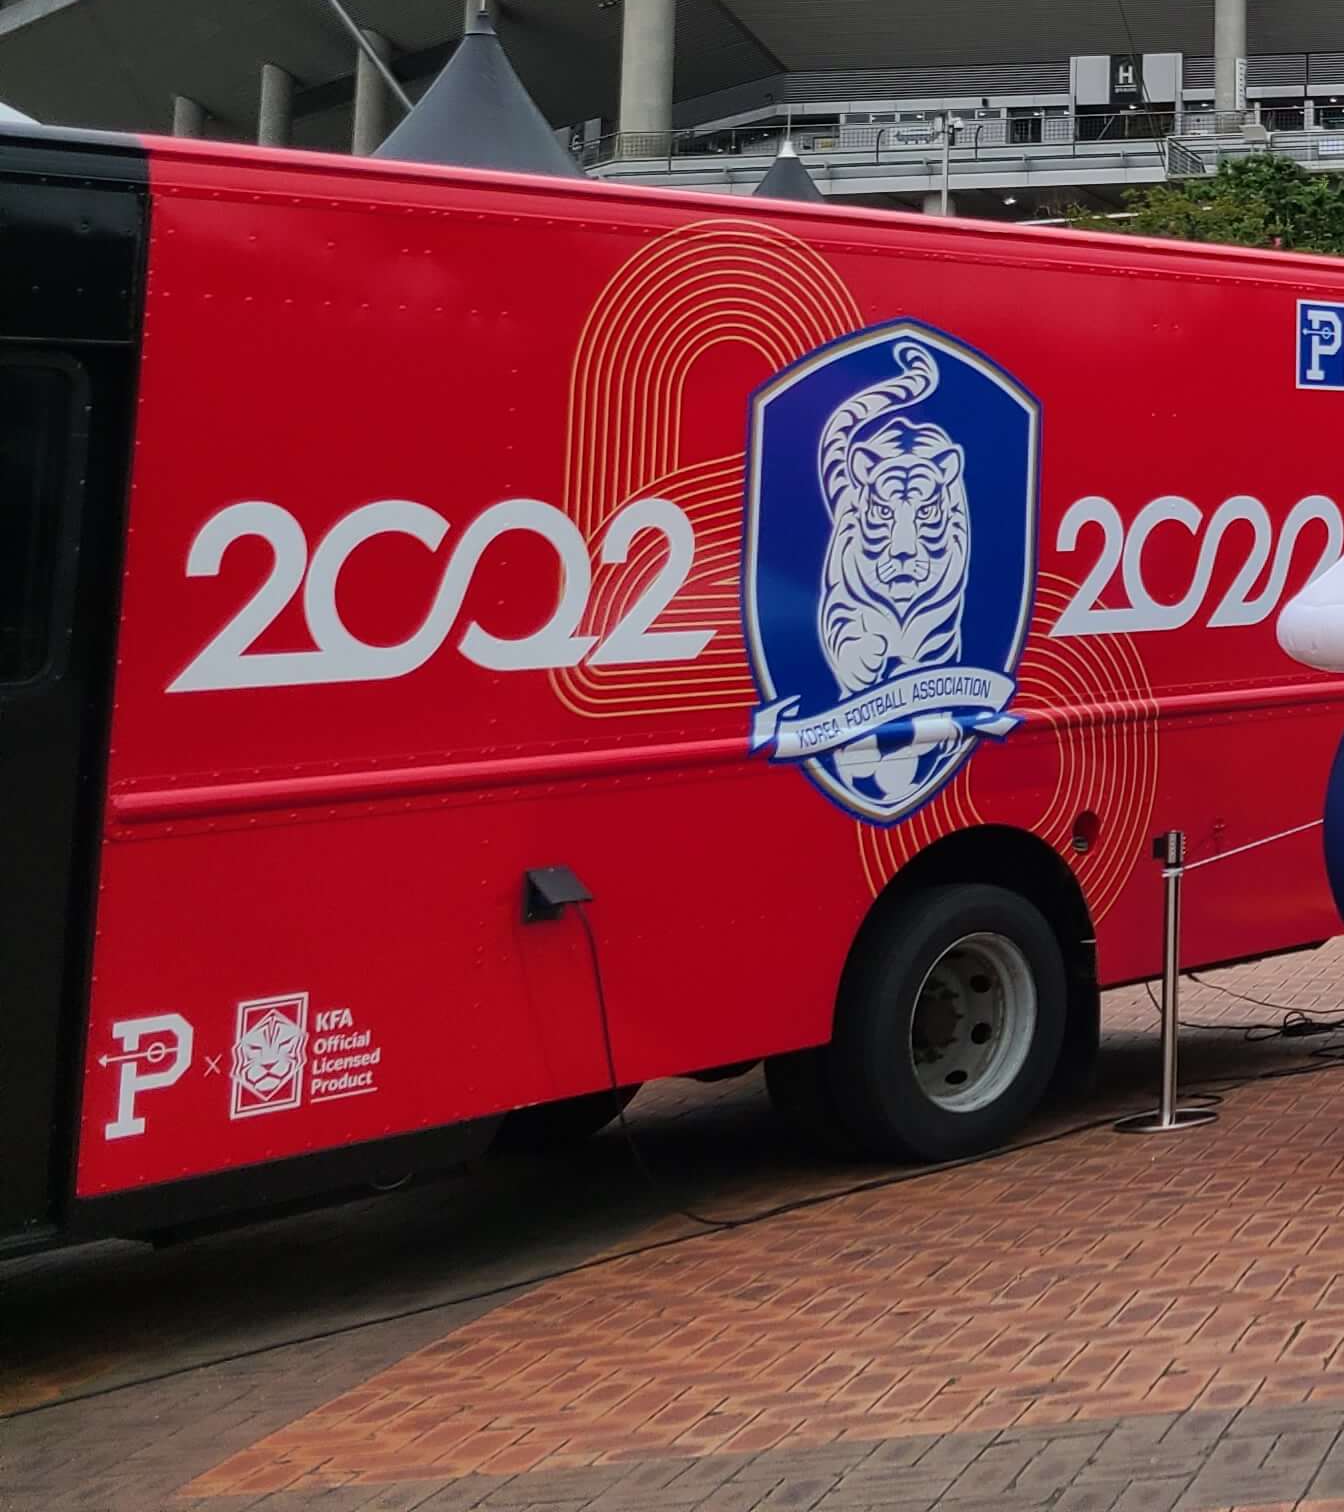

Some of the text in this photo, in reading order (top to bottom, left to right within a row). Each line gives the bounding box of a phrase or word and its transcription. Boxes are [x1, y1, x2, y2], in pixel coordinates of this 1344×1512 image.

[1119, 65, 1134, 84] H
[795, 676, 992, 749] KOREA FOOTBALL ASSOCIATION
[314, 1008, 354, 1033] KFA
[313, 1030, 371, 1055] Official
[311, 1048, 381, 1075] Licensed
[310, 1070, 373, 1095] Product
